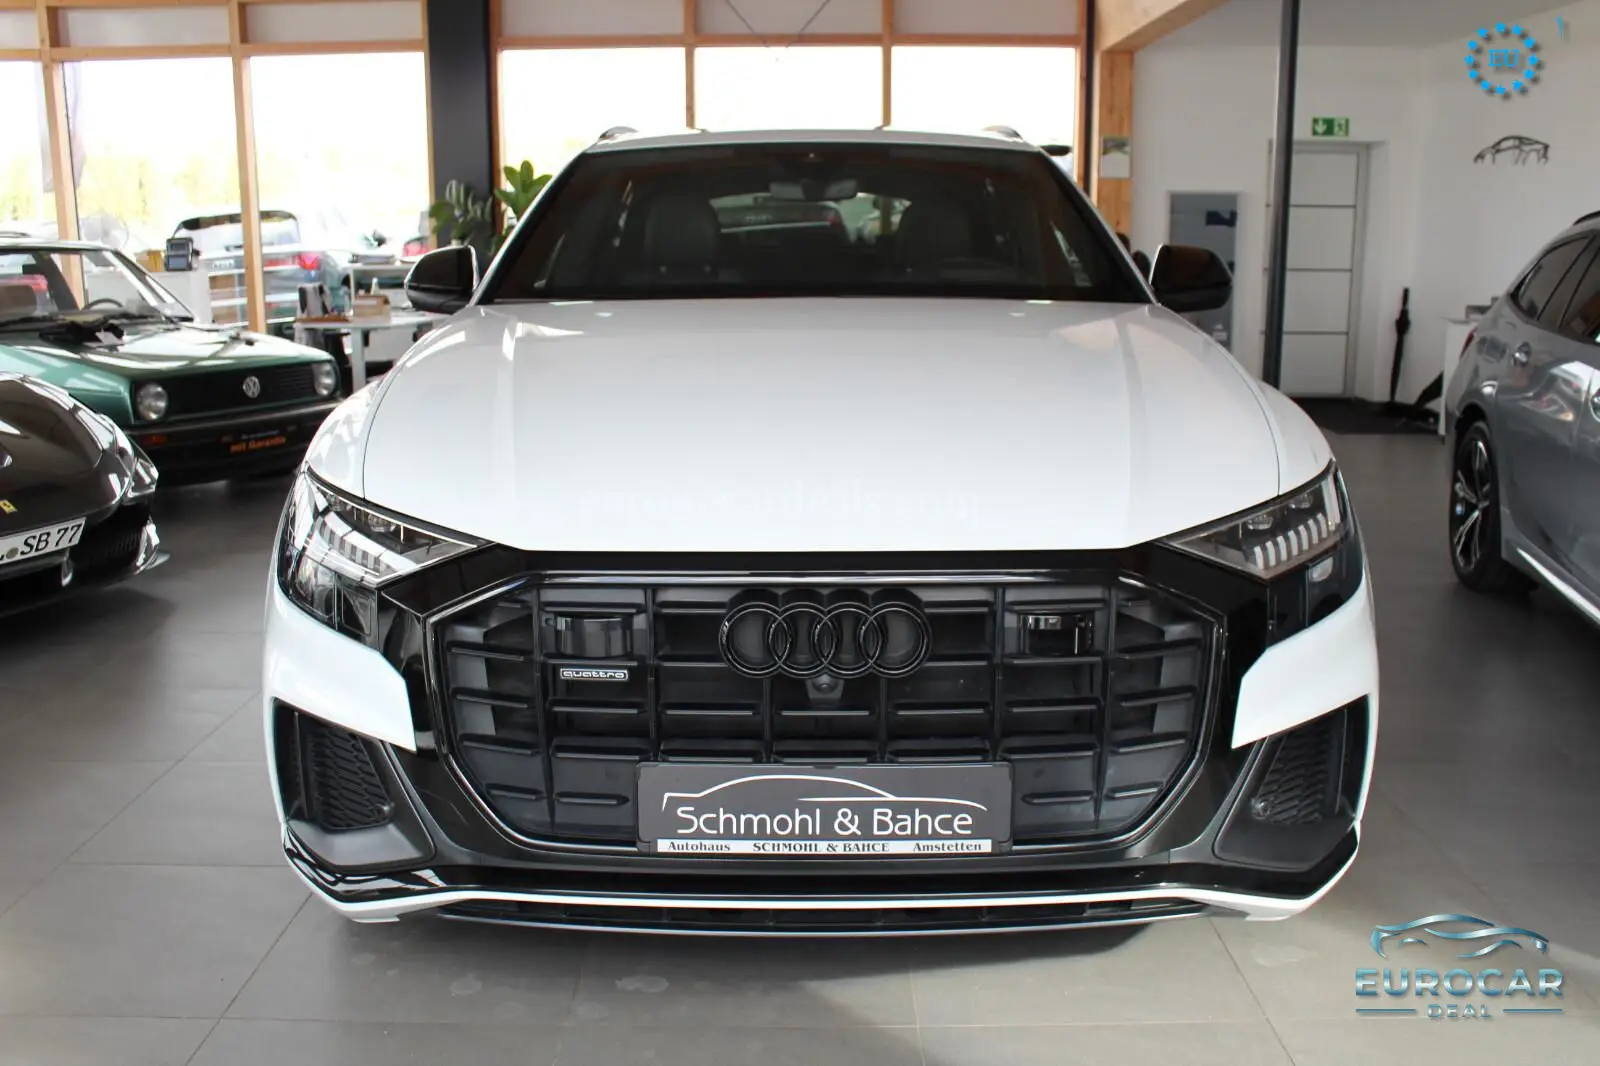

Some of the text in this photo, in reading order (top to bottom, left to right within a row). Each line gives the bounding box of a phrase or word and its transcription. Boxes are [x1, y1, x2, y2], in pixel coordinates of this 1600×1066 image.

[20, 523, 83, 556] SB 77
[563, 670, 625, 679] quattro
[676, 806, 973, 836] Schmohl & Bahce
[667, 841, 983, 853] Autohaus SCHMOHL & BAHCE Amstetten
